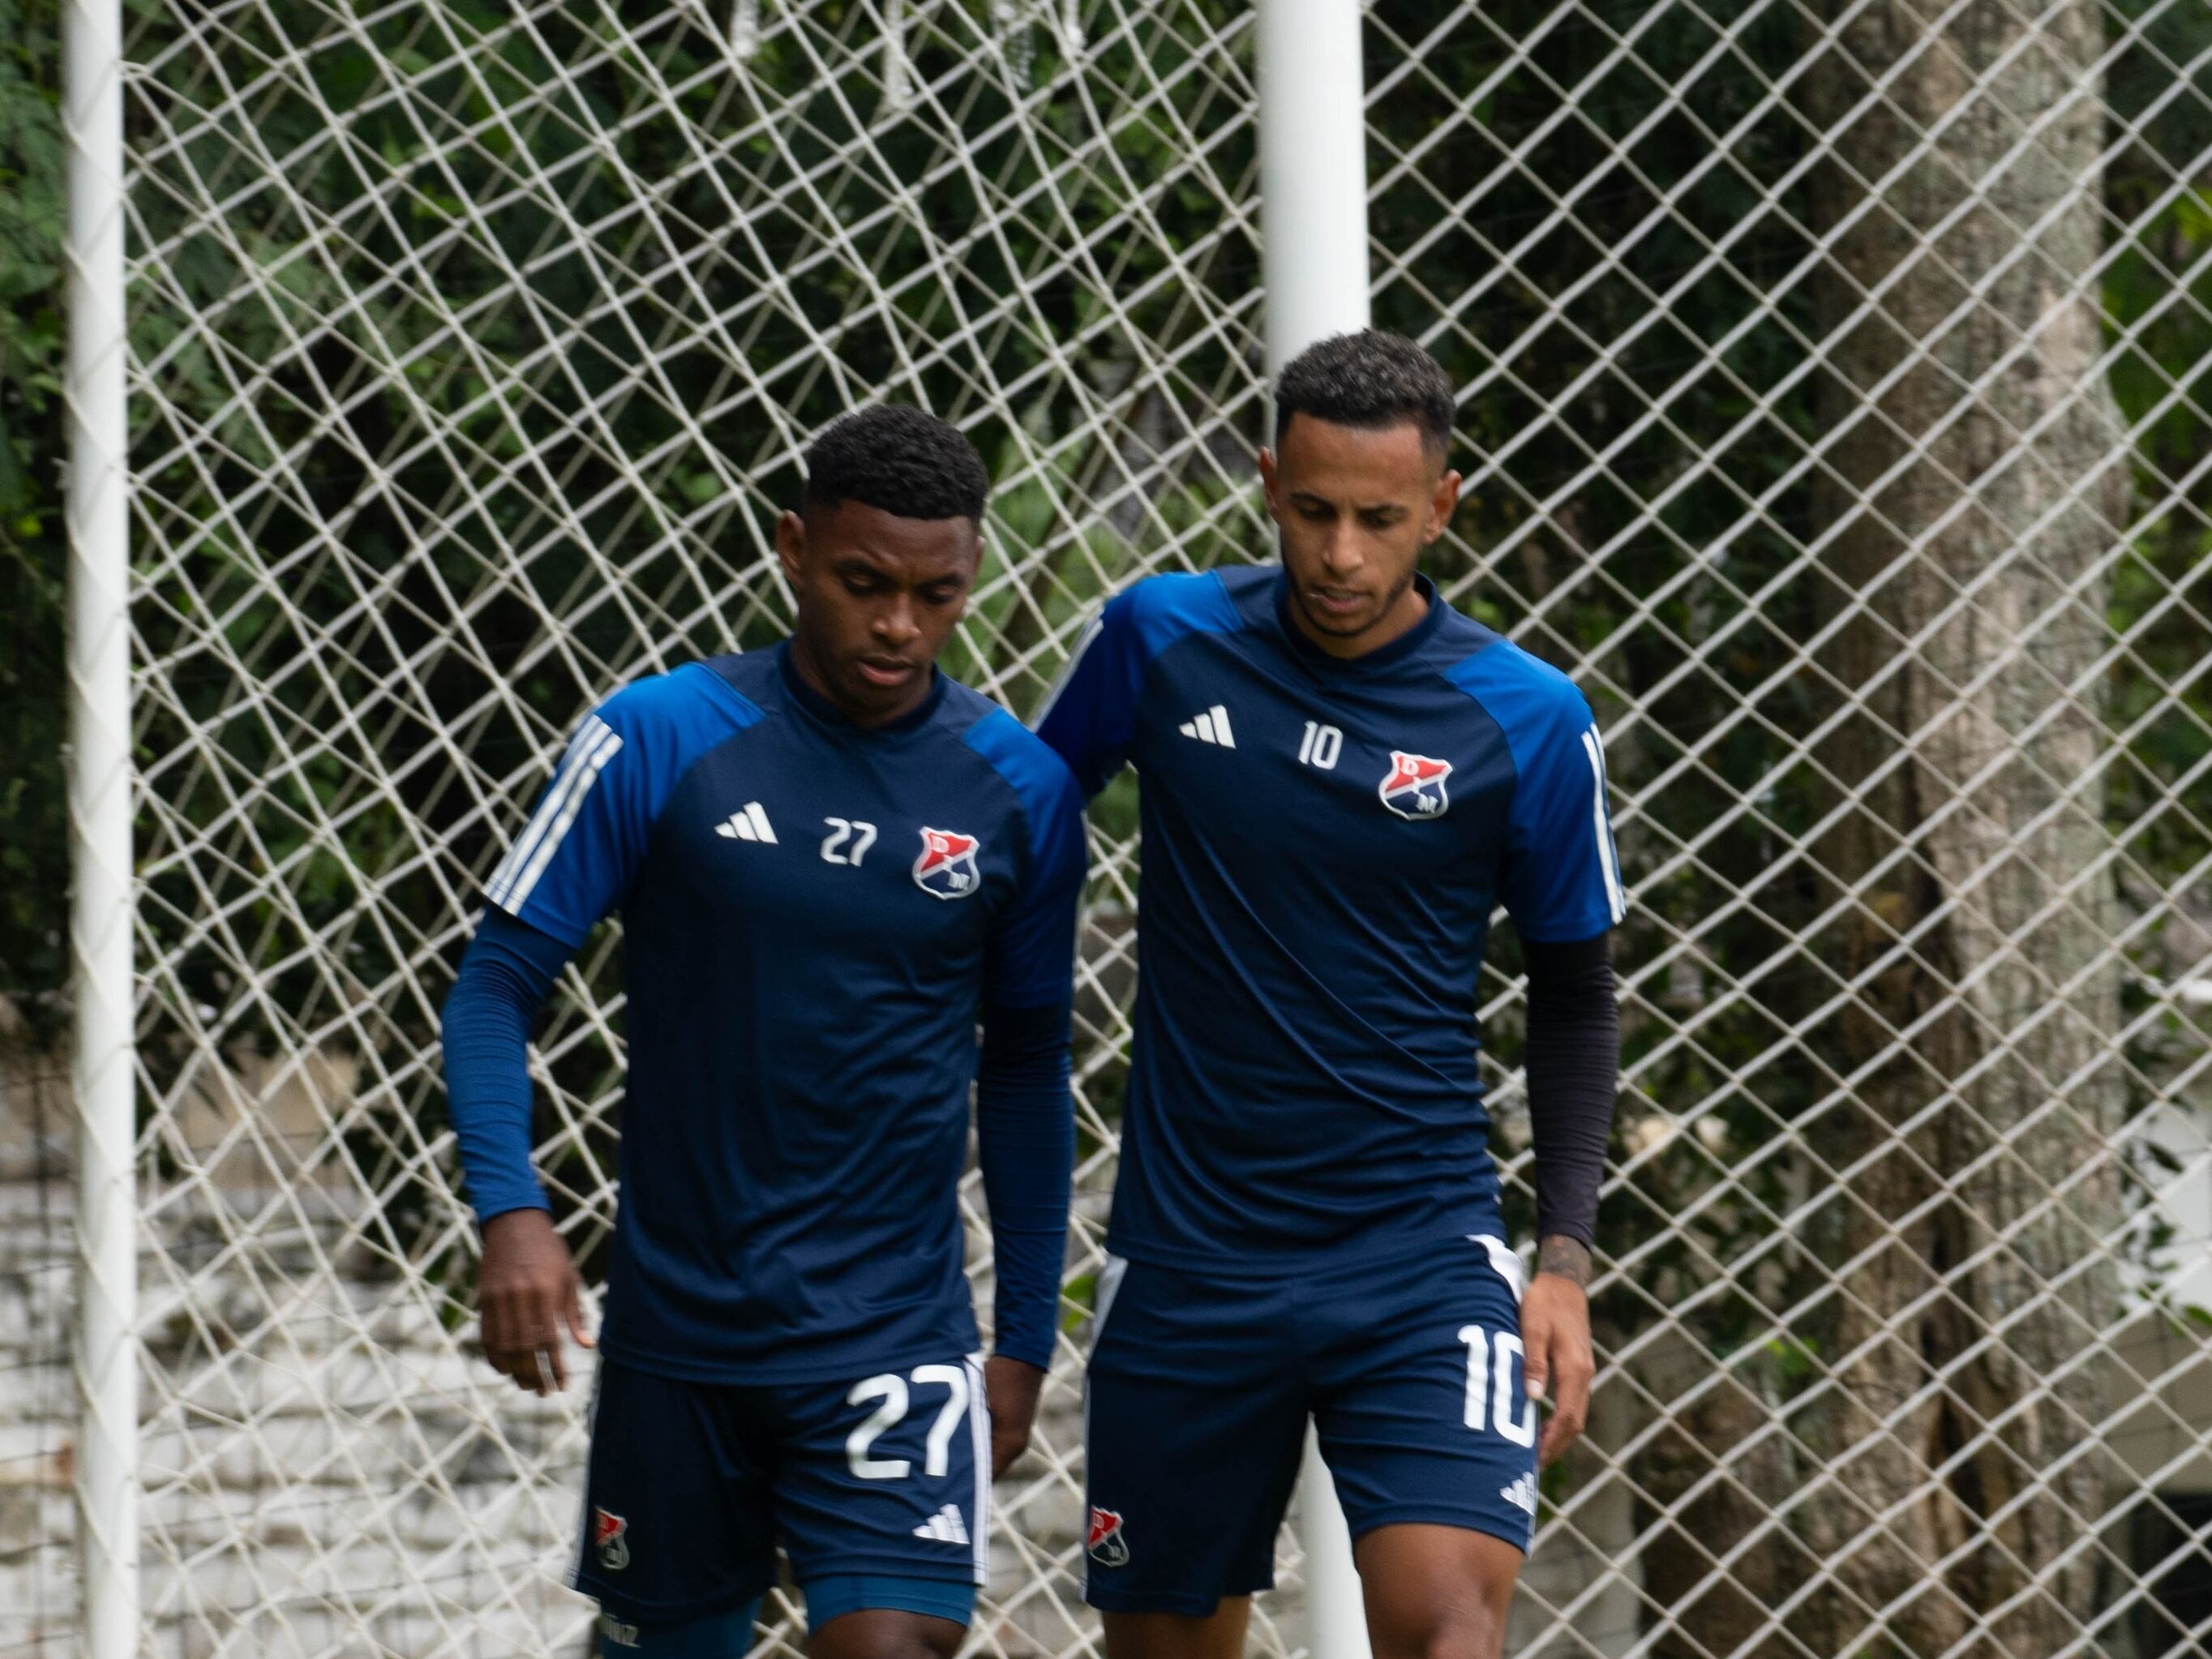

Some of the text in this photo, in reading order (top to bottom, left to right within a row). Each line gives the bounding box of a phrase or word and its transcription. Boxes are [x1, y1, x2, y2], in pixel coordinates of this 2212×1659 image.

[1298, 720, 1344, 769] 10
[820, 817, 877, 867] 27
[846, 1365, 969, 1478] 27
[1457, 1324, 1536, 1448] 10
